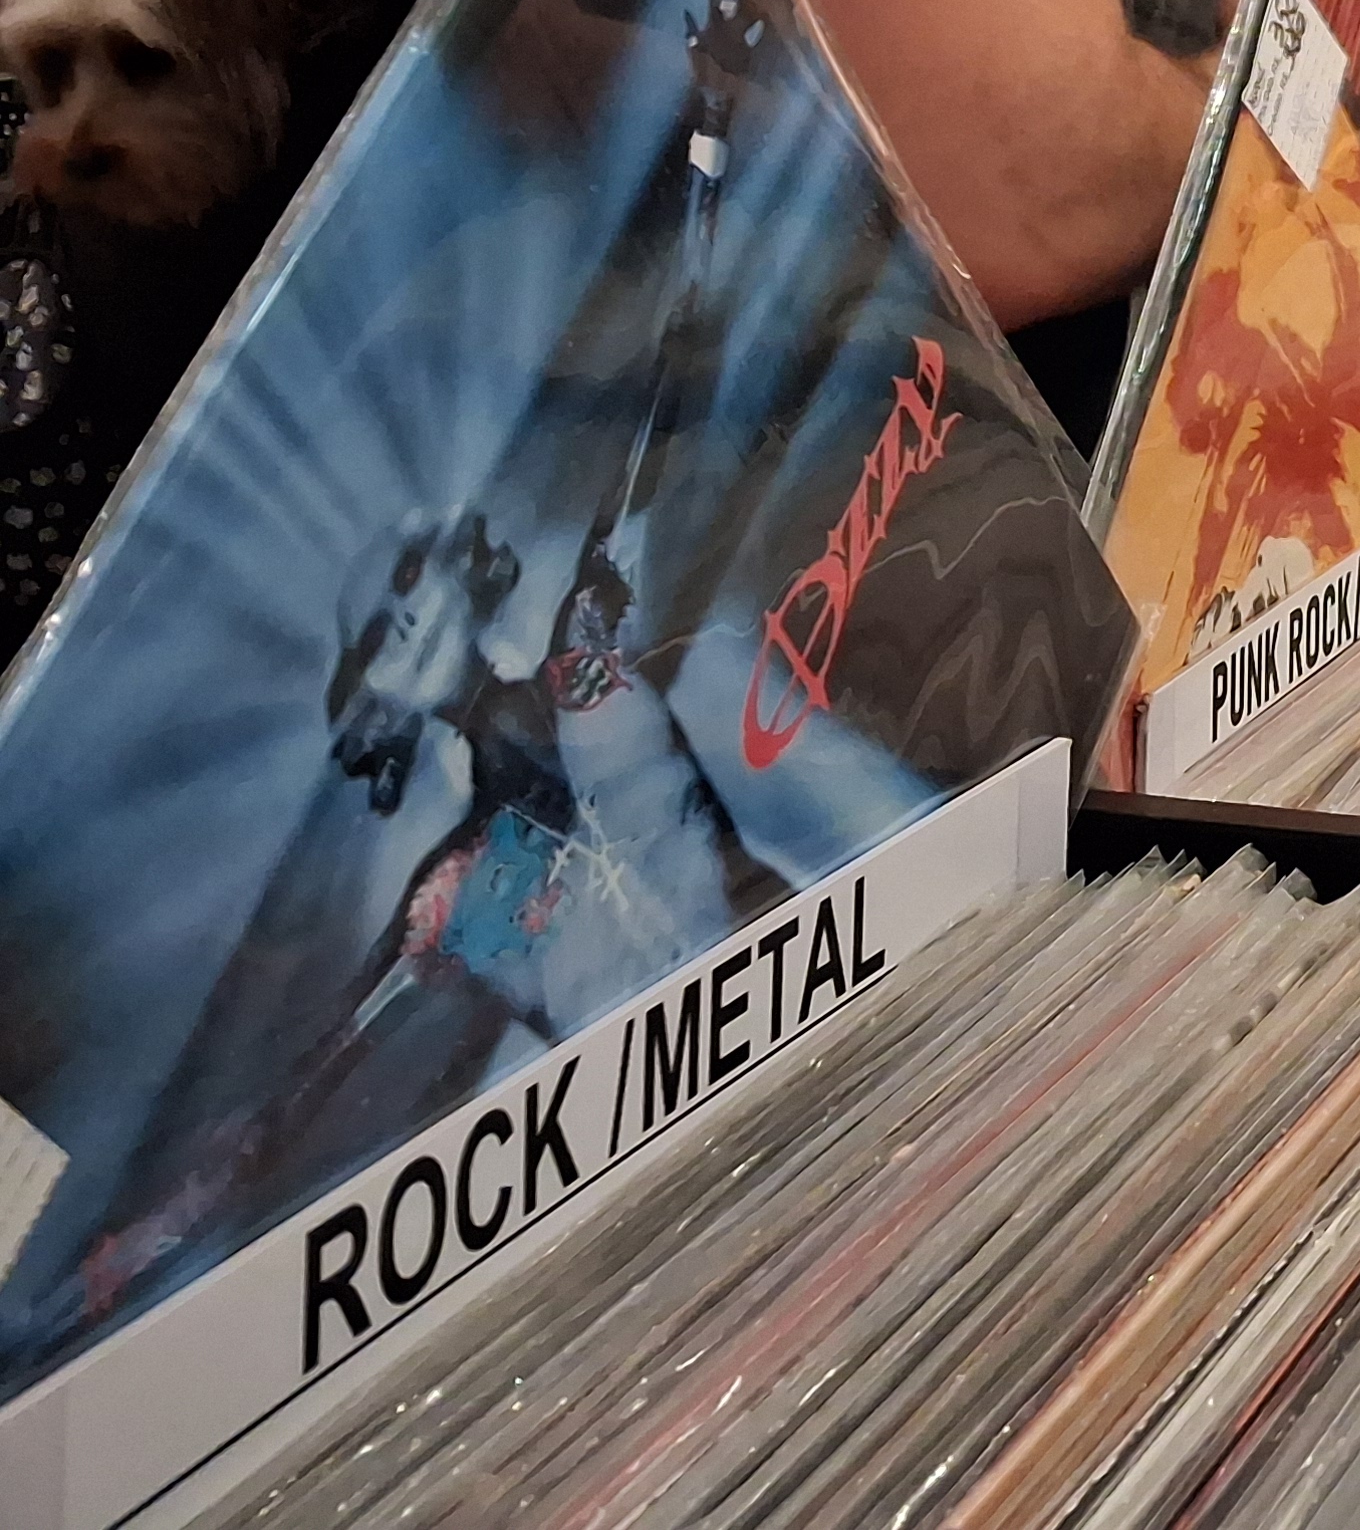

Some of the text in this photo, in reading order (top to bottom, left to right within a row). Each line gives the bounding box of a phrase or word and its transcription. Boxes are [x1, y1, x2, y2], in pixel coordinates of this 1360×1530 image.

[1209, 623, 1281, 743] PUNK
[302, 875, 888, 1375] ROCK /METAL
